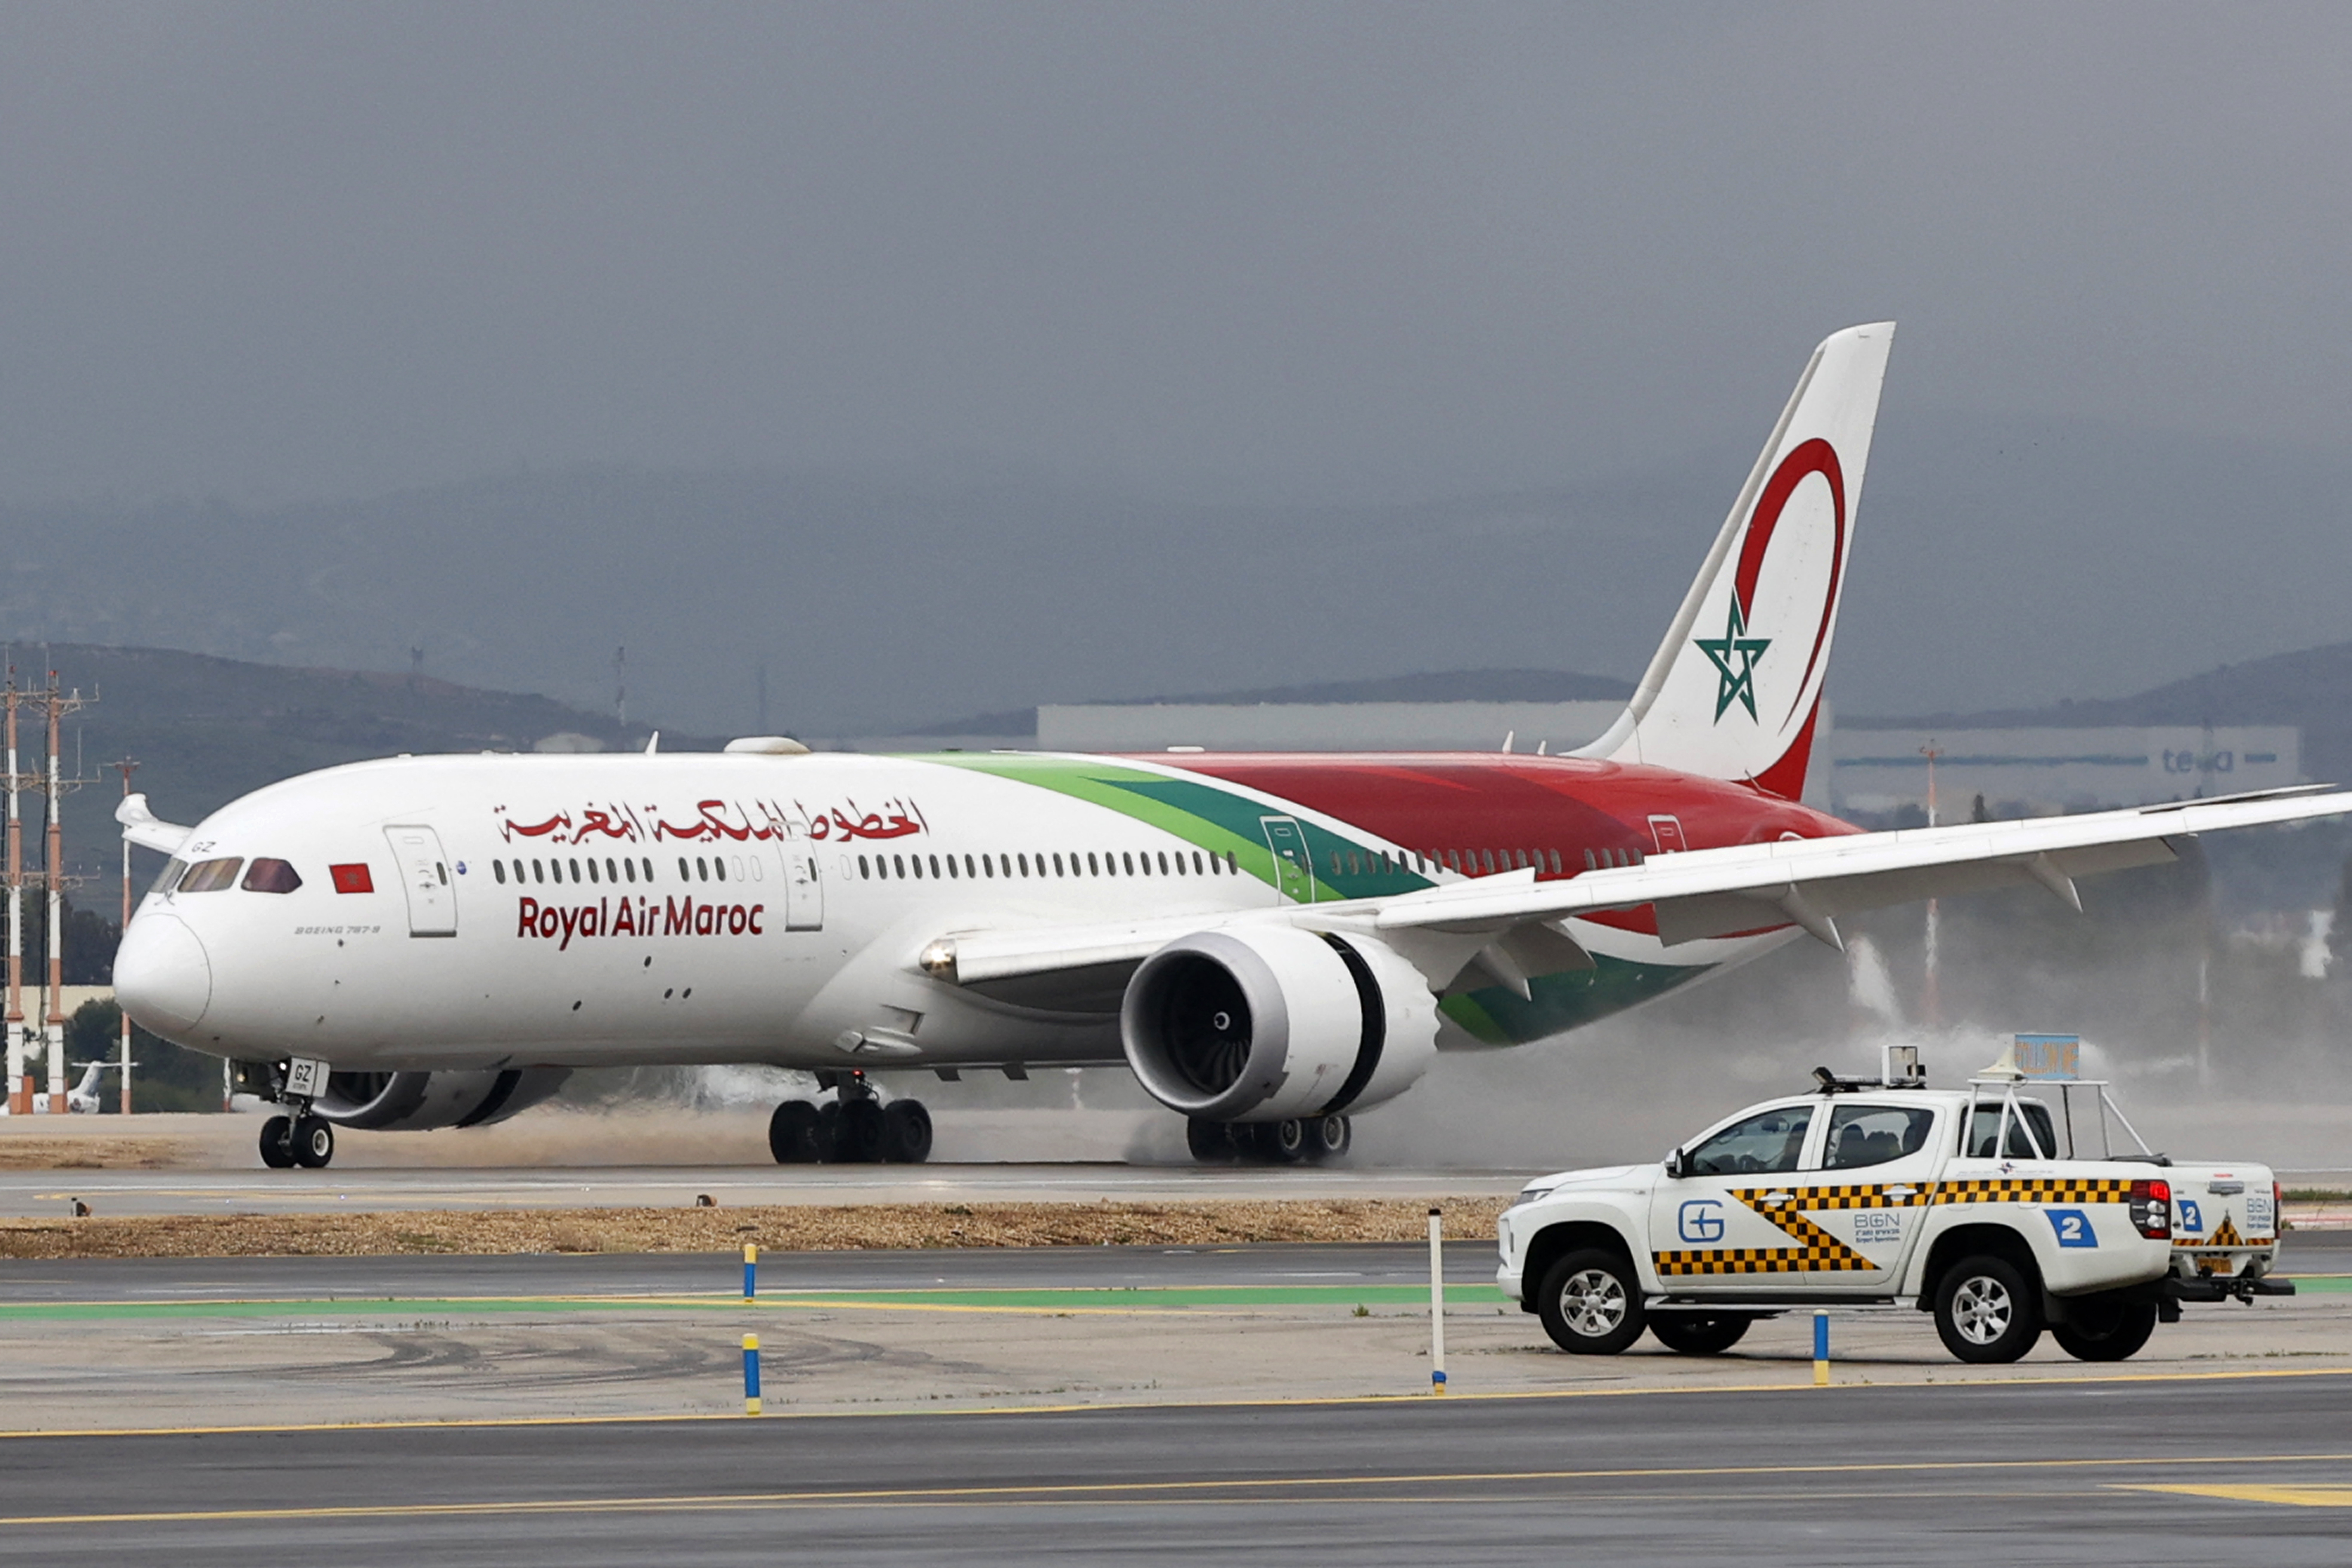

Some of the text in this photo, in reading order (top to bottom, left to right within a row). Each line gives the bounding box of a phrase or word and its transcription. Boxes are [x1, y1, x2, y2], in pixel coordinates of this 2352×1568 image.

[494, 796, 930, 845] الخطوط الملكية المغربية
[192, 841, 217, 853] GZ
[294, 926, 344, 935] BOEING
[518, 895, 764, 952] Royal Air Maroc
[295, 1064, 311, 1082] GZ
[1854, 1213, 1900, 1228] BGN
[2185, 1206, 2196, 1225] 2
[2061, 1216, 2082, 1240] 2
